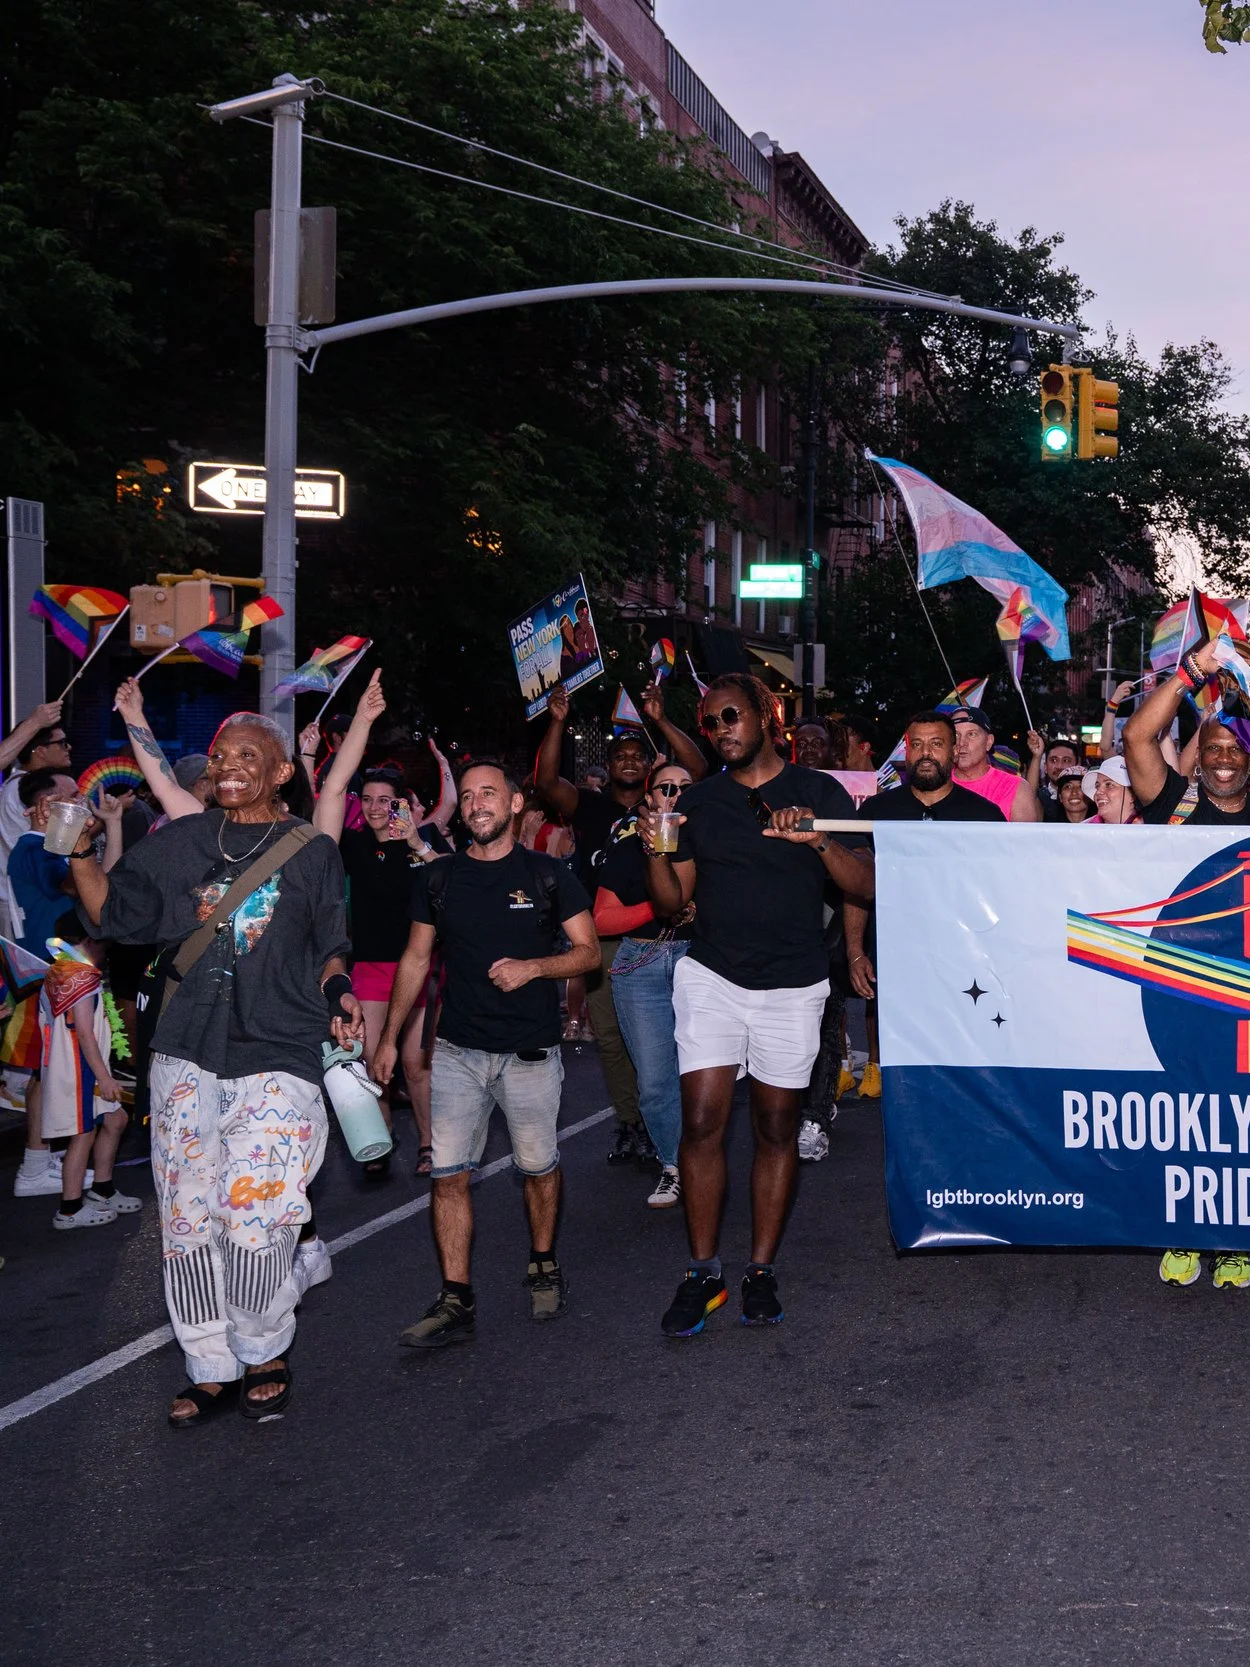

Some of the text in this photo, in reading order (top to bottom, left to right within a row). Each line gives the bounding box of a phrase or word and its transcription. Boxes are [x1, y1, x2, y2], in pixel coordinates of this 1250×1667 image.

[221, 480, 321, 501] ONE AY
[510, 617, 534, 646] PASS
[514, 619, 561, 663] NEW YORK
[519, 646, 553, 682] FOR ALL
[926, 1188, 1085, 1210] lgbtbrooklyn.org
